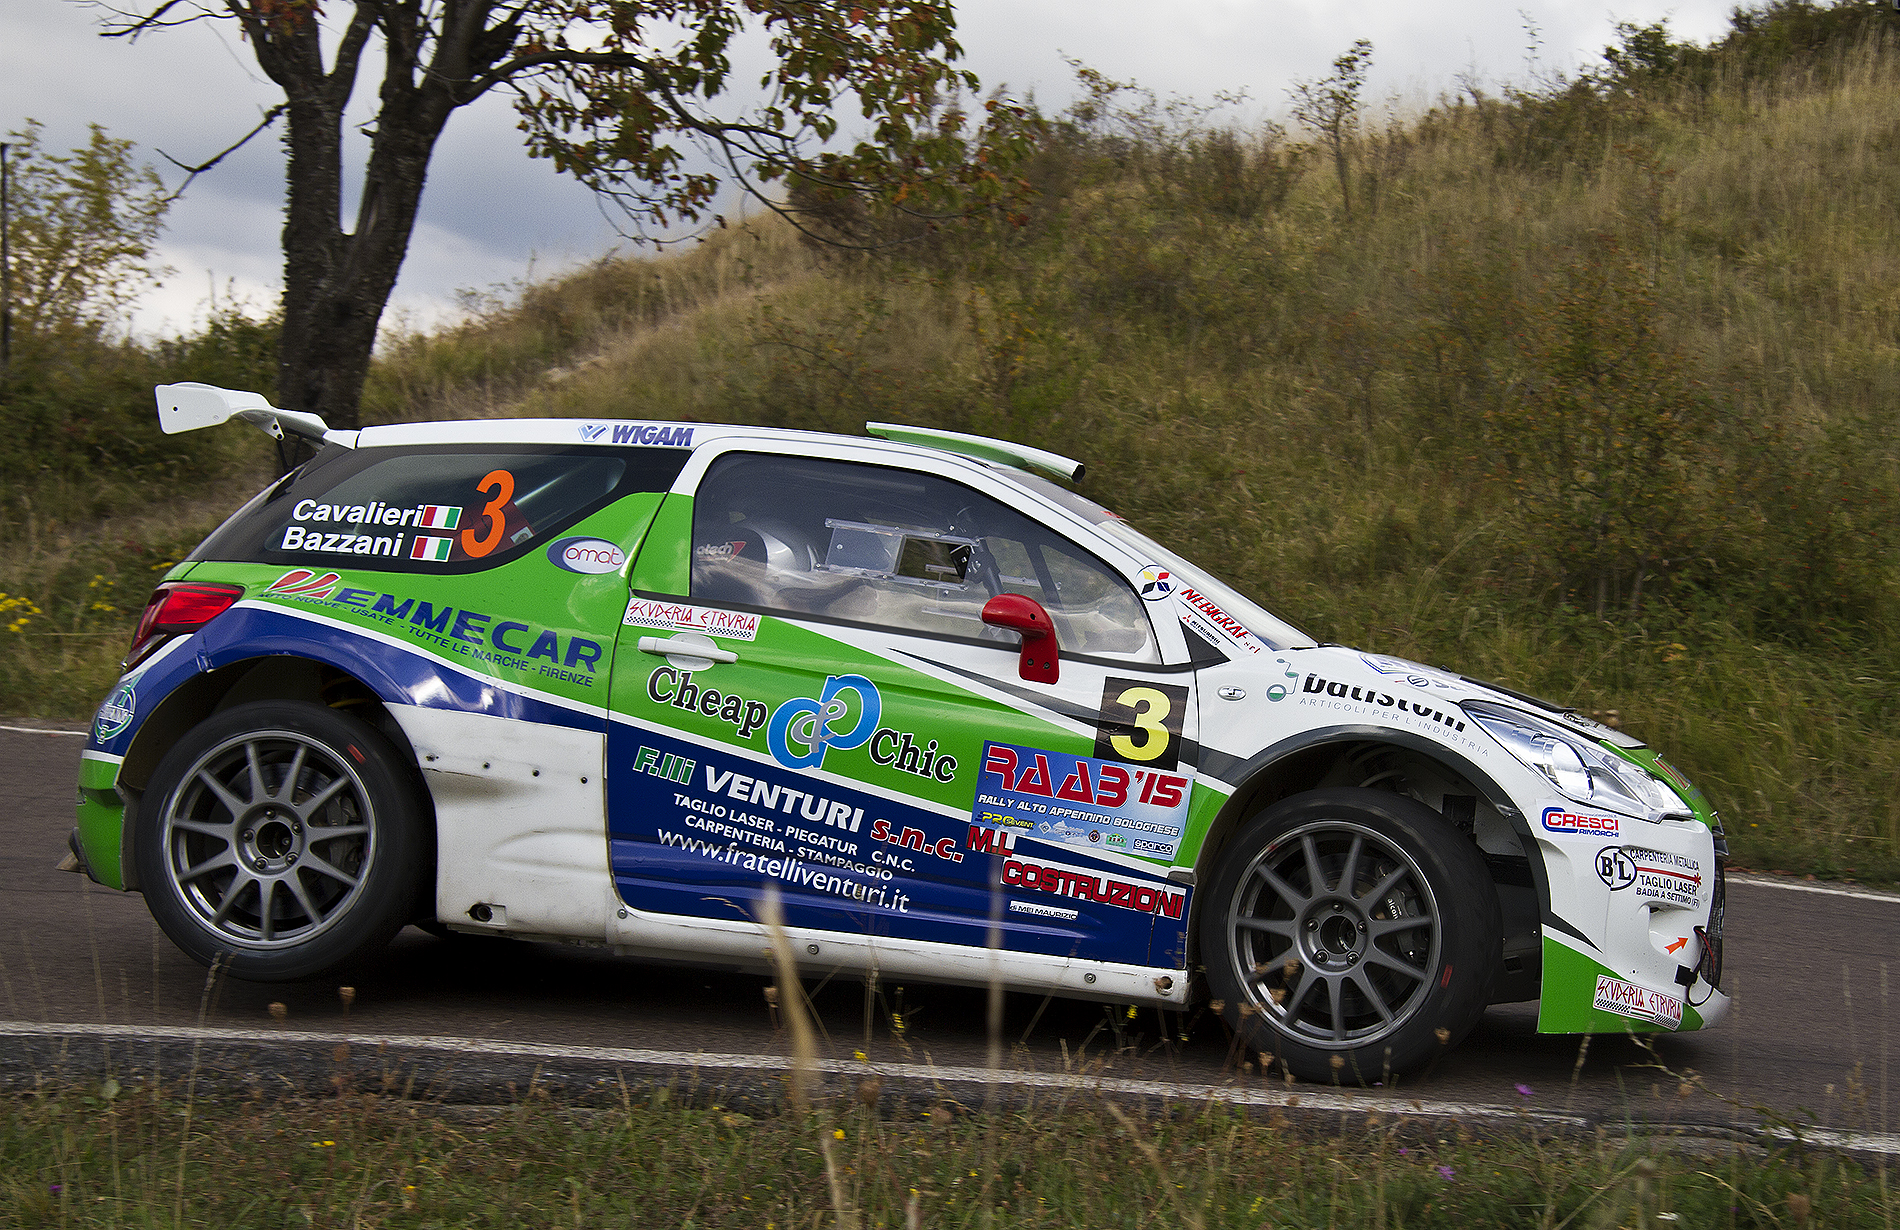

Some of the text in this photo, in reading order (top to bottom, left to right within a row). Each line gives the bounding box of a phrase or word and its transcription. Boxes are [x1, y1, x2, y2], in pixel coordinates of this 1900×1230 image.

[611, 424, 695, 447] WIGAM
[292, 498, 421, 528] Cavalieri
[461, 469, 515, 559] 3
[281, 526, 404, 557] Bazzani
[566, 545, 623, 567] omat
[332, 587, 603, 674] EMMECAR
[1180, 588, 1254, 639] NEBIGRAF
[257, 592, 594, 688] AUTO NUOVE USATE TUTTE LE MARCHE FIRENZE
[647, 665, 768, 738] Cheap
[869, 728, 957, 783] Chic
[1109, 685, 1172, 762] 3
[1299, 697, 1491, 758] ARTICOLI PER L'INDUSTRIA
[673, 793, 916, 874] TAGLIO LASER PIEGATUR C.N.C.
[704, 765, 865, 833] VENTURI
[869, 818, 965, 863] s.n.c.
[977, 794, 1181, 838] RALLY ALTO APPENNINO BOLOGNESE
[1547, 812, 1619, 831] CRESCI
[1579, 828, 1620, 838] RIMORCHI
[656, 828, 911, 914] www.fratelliventuri.it
[684, 815, 894, 882] CARPENTERIA STAMPAGGIO
[1134, 839, 1174, 853] sparco
[1629, 848, 1674, 866] CARPENTERIA
[1002, 860, 1184, 919] COSTRUZIONI
[1635, 887, 1660, 898] BADIA
[1660, 890, 1667, 899] A
[1666, 891, 1692, 905] SETTIMO
[1639, 874, 1698, 897] TAGLIO LASER
